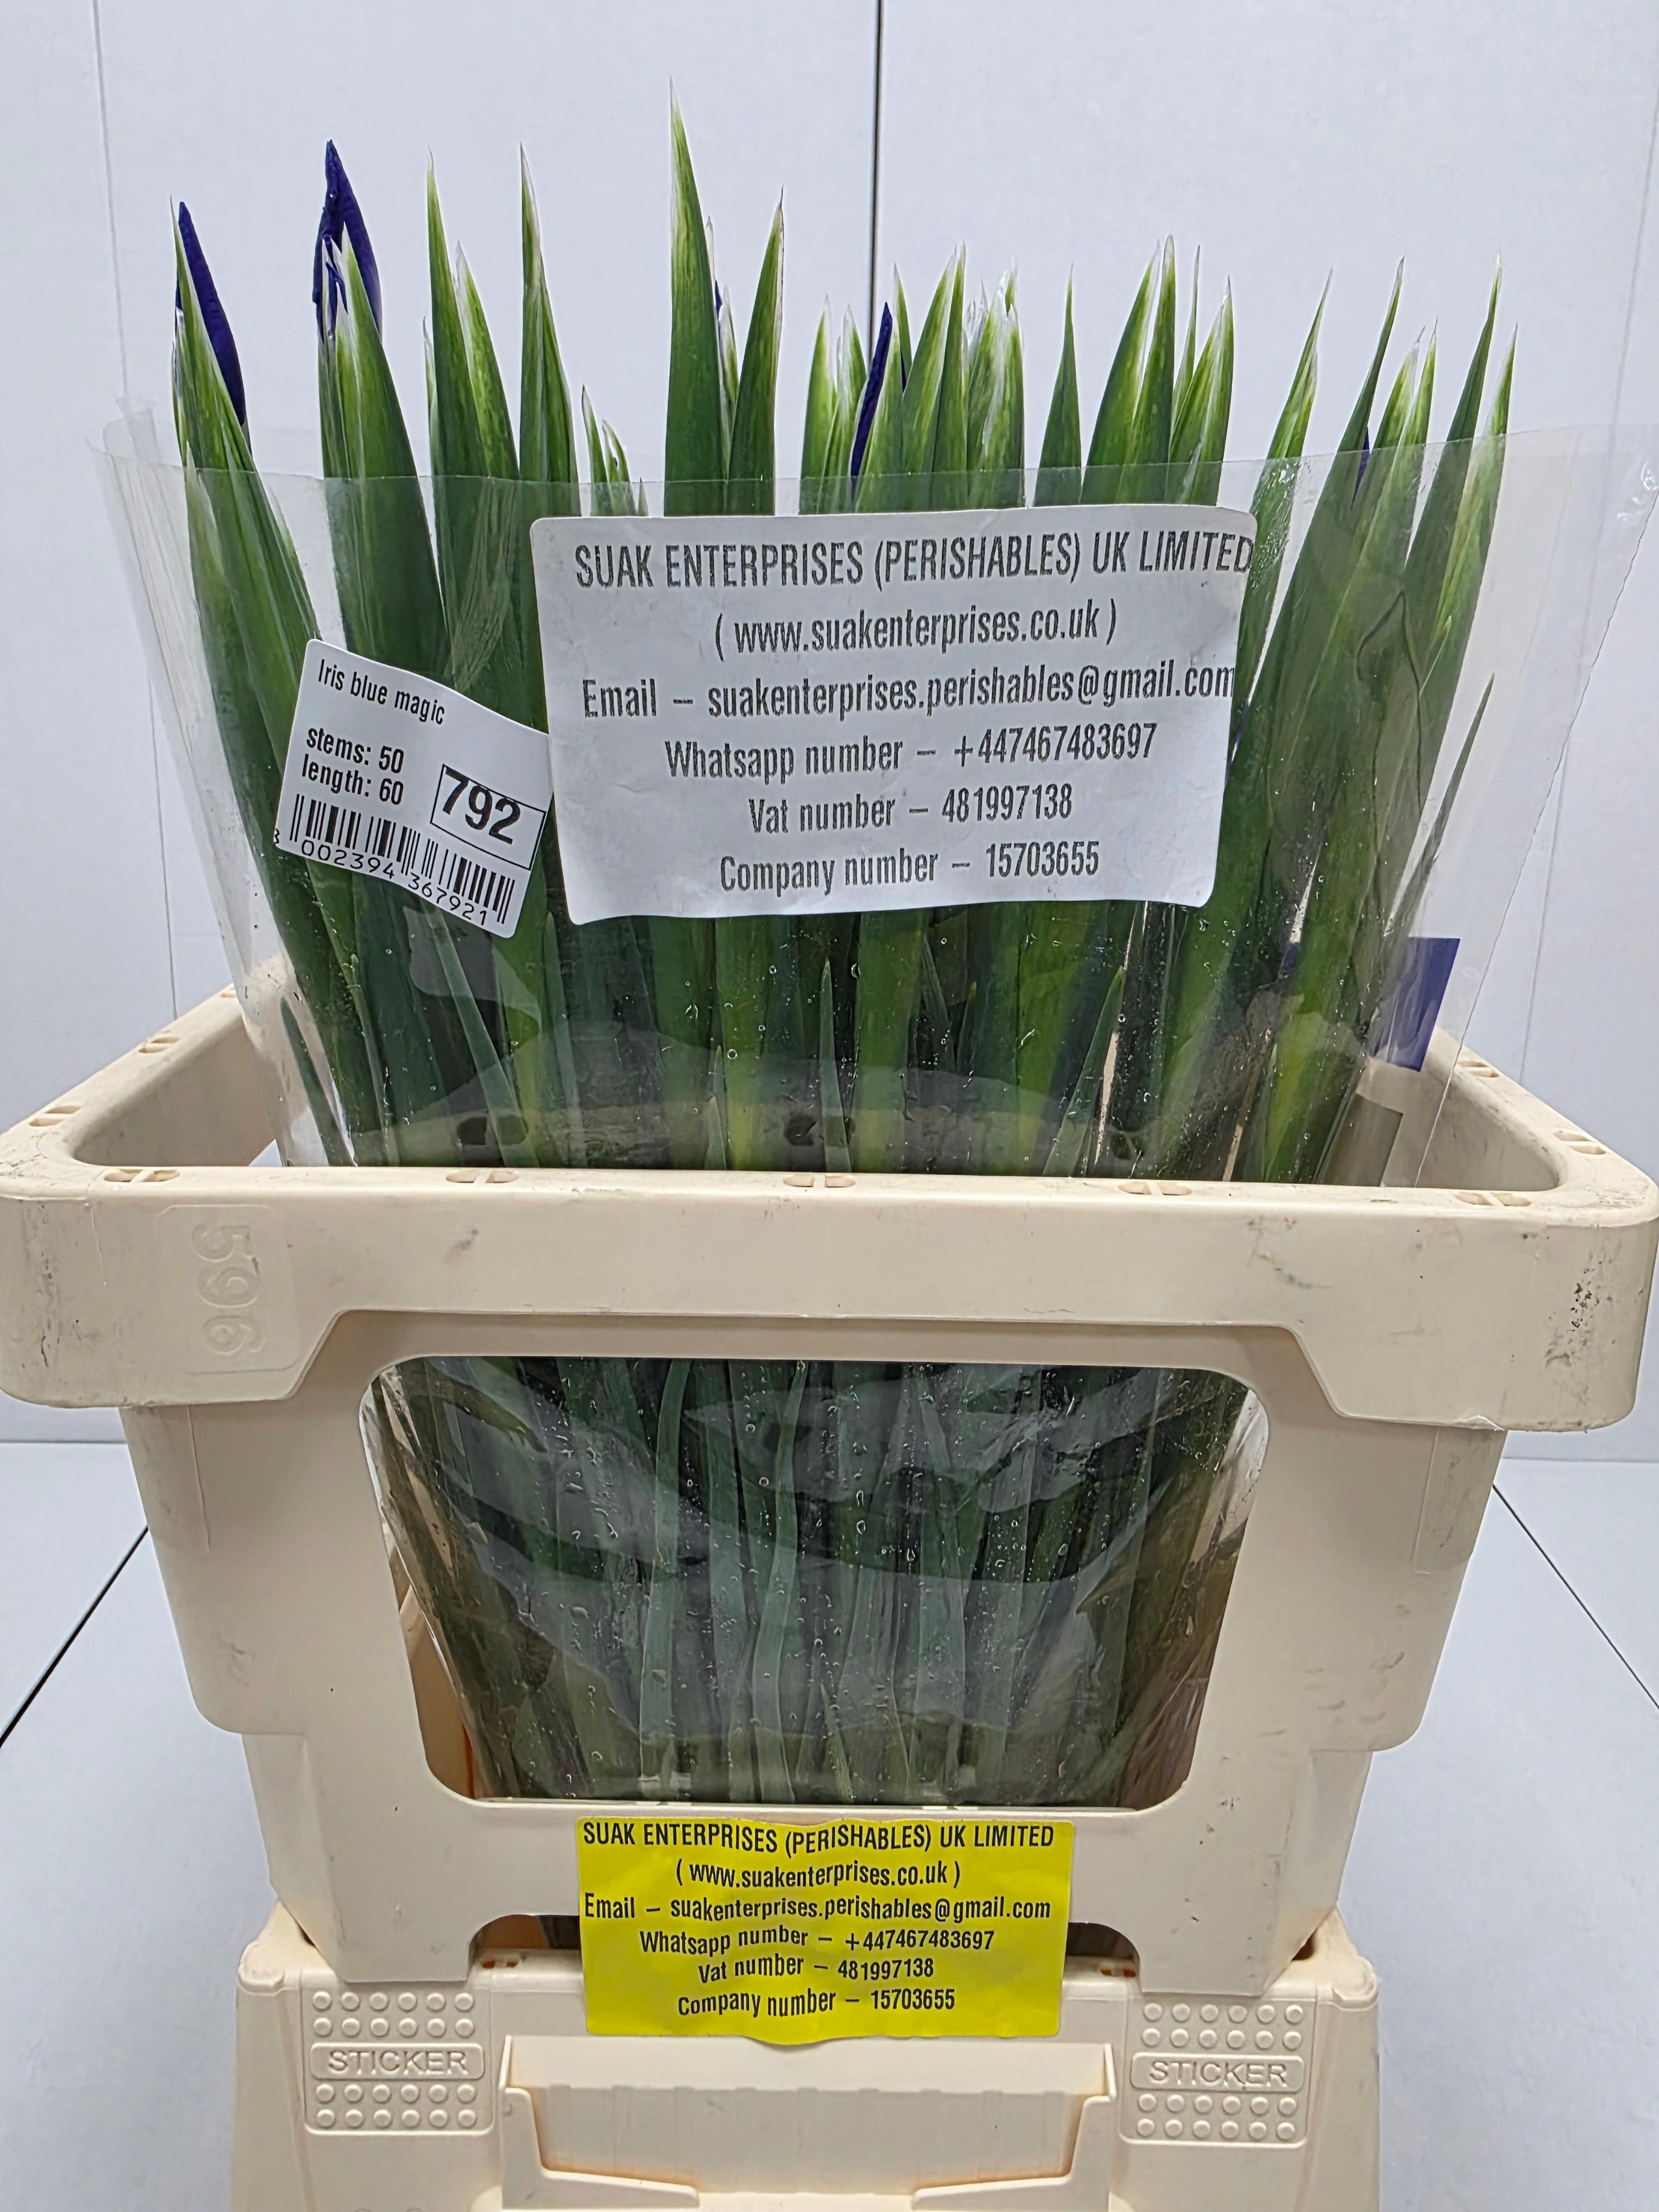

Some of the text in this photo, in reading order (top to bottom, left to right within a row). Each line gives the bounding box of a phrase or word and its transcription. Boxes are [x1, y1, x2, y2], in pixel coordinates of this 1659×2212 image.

[576, 530, 1253, 592] SUAK ENTERPRISES (PERISHABLES) UK LIMITED
[734, 599, 1099, 654] www.suakenterprises.co.uk
[319, 659, 444, 724] Iris blue magic
[583, 679, 656, 717] Email
[307, 728, 404, 773] stems: 50
[665, 741, 794, 785] Whatsapp
[806, 735, 903, 774] number
[954, 723, 1157, 767] +447467483697
[302, 754, 404, 805] length: 60
[442, 768, 521, 844] 792
[749, 799, 788, 833] Vat
[800, 794, 895, 832] number
[942, 783, 1072, 822] 481997138
[301, 839, 489, 926] 002394 367921
[721, 856, 834, 897] Company
[846, 848, 938, 885] number
[986, 841, 1099, 877] 15703655
[583, 1822, 1054, 1858] SUAK ENTERPRISES (PERISHABLES) UK LIMITED
[690, 1860, 947, 1887] www.suakenterprises.co.uk
[585, 1892, 634, 1918] Email
[671, 1895, 1050, 1923] suakenterprises.perishables@gmail.com
[640, 1931, 730, 1957] Whatsapp
[739, 1924, 808, 1946] number
[846, 1929, 994, 1951] +447467483697
[698, 1961, 727, 1983] Vat
[735, 1953, 804, 1976] number
[838, 1958, 933, 1980] 481997138
[679, 1993, 760, 2018] Company
[768, 1988, 836, 2017] number
[871, 1989, 954, 2010] 15703655
[328, 2051, 469, 2075] STICKER
[1149, 2061, 1287, 2088] STICKER
